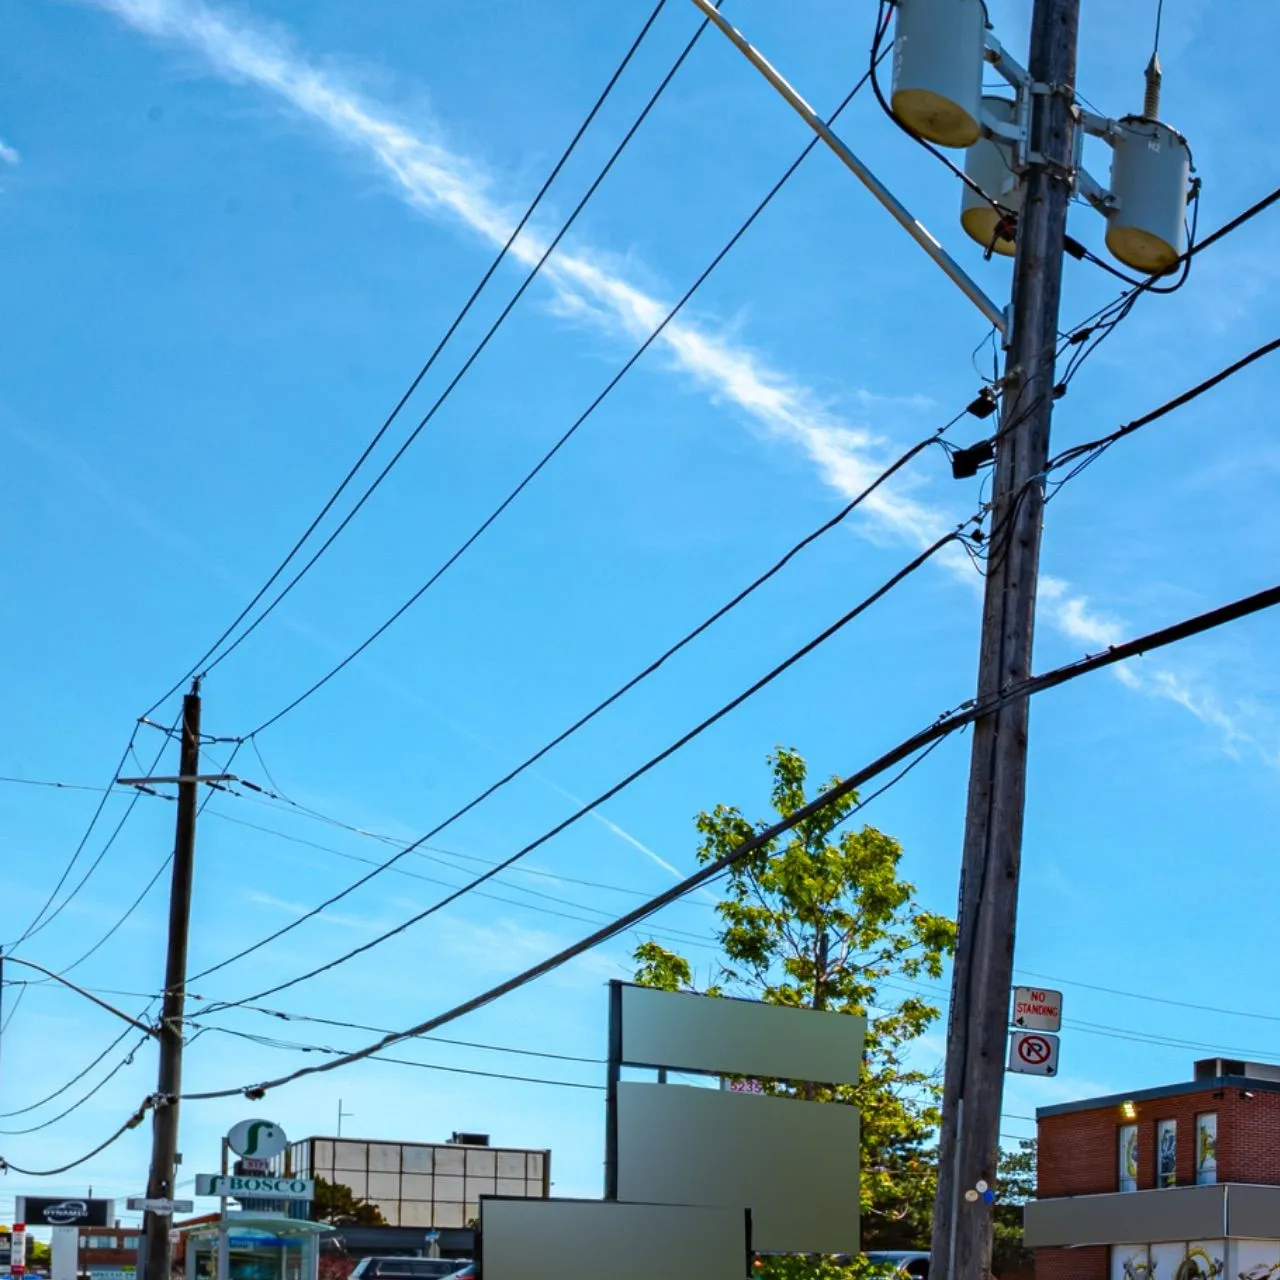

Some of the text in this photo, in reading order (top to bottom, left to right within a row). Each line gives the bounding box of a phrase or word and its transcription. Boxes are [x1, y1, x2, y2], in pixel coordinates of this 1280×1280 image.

[1031, 991, 1046, 1002] NO
[1016, 1002, 1058, 1017] STANDING
[229, 1177, 306, 1193] BOSCO
